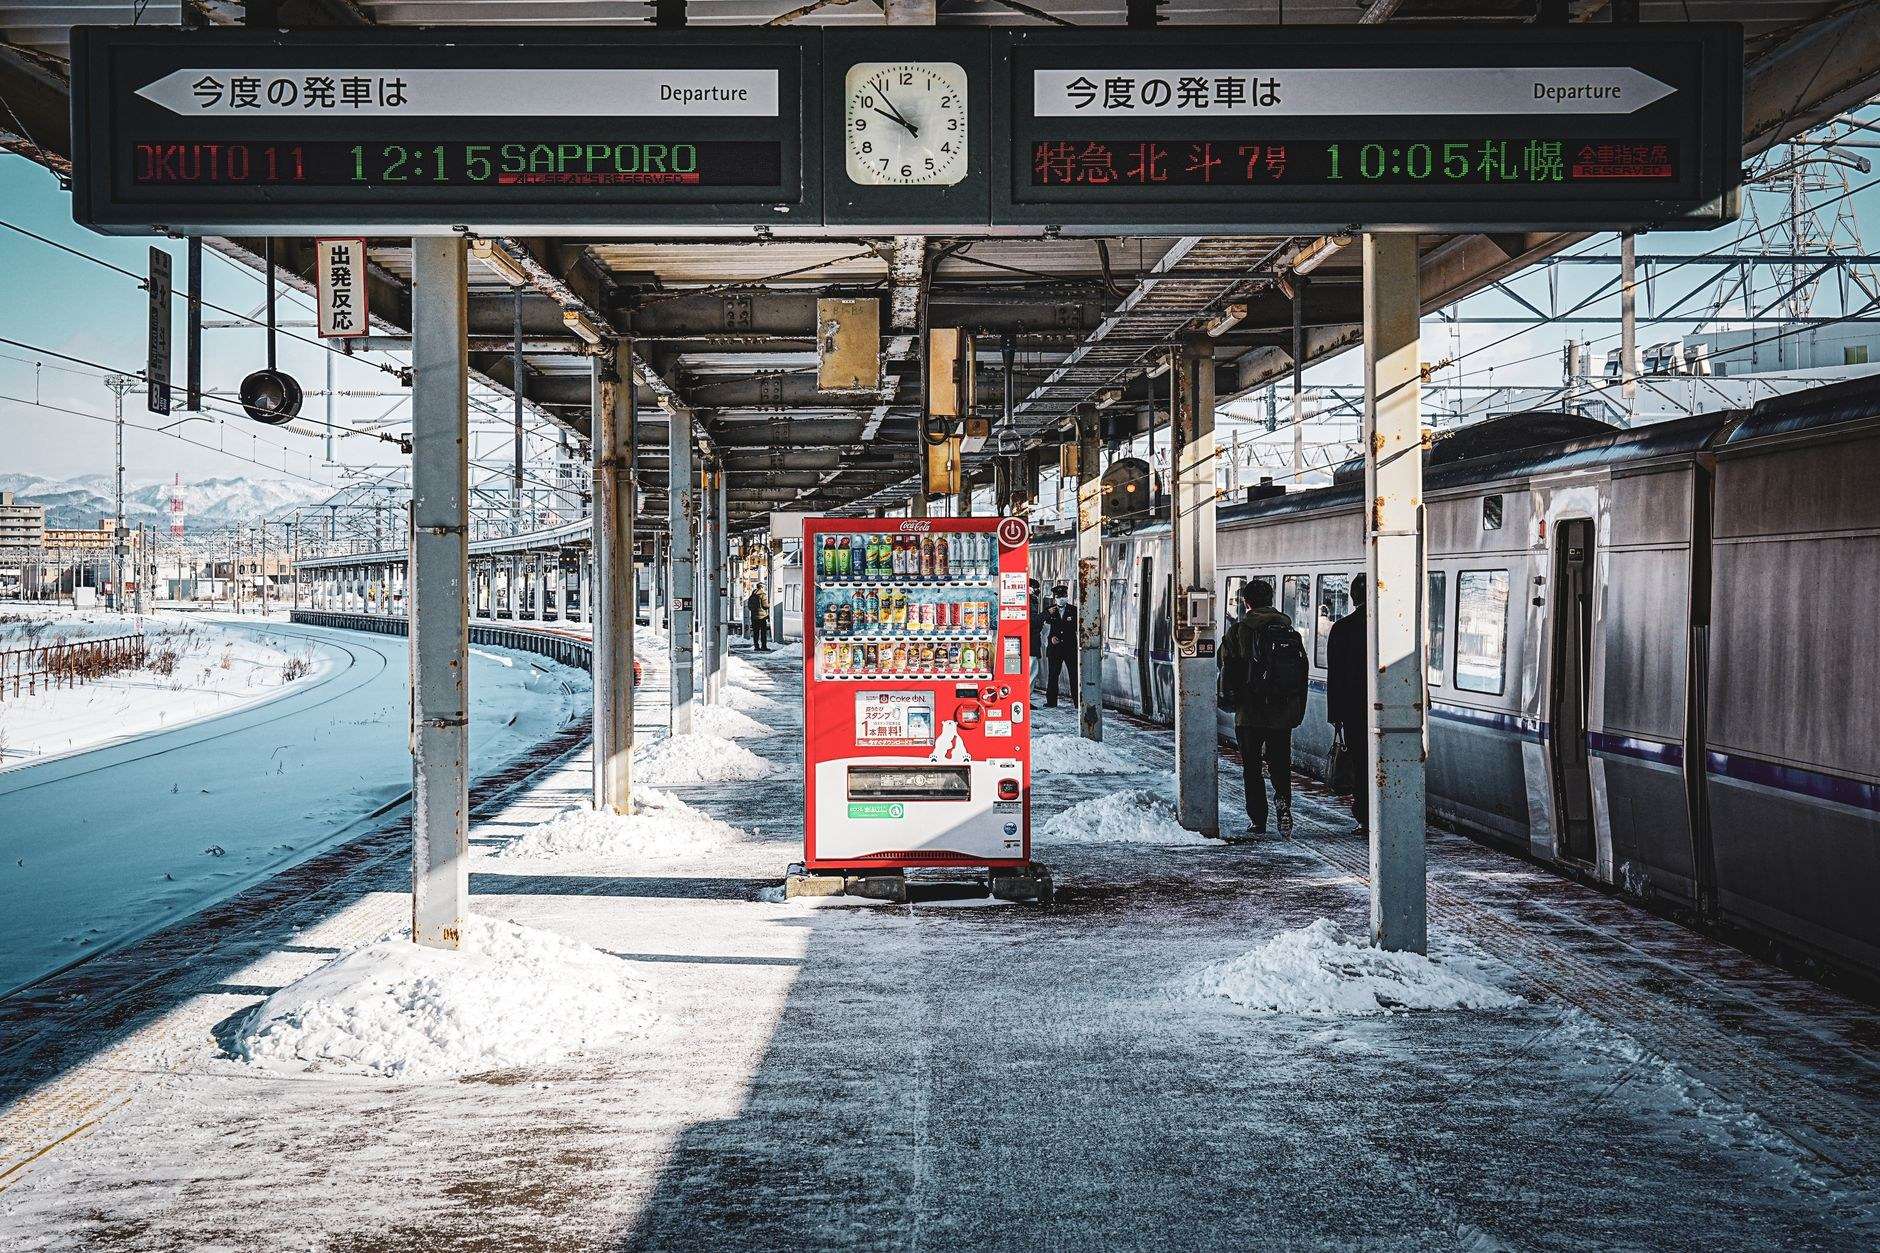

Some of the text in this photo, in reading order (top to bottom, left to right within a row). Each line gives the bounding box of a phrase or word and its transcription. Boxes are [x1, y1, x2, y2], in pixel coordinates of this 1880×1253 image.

[878, 78, 889, 92] 11
[899, 72, 913, 86] 12
[927, 78, 931, 91] 1
[192, 76, 408, 108] 今度の発車は
[660, 84, 748, 105] Departure
[1066, 76, 1282, 109] 今度の発車は
[1533, 83, 1622, 103] Departure
[860, 95, 874, 109] 10
[940, 95, 951, 109] 2
[855, 118, 867, 131] 9
[946, 118, 958, 131] 3
[861, 141, 873, 154] 8
[940, 141, 951, 154] 4
[263, 146, 305, 180] 11
[351, 144, 697, 181] 12:15 SAPPORO
[878, 158, 890, 171] 7
[924, 158, 935, 170] 5
[1326, 139, 1564, 182] 10:05 札幌
[900, 164, 913, 177] 6
[330, 245, 353, 331] 出発反応
[889, 695, 911, 703] Coke
